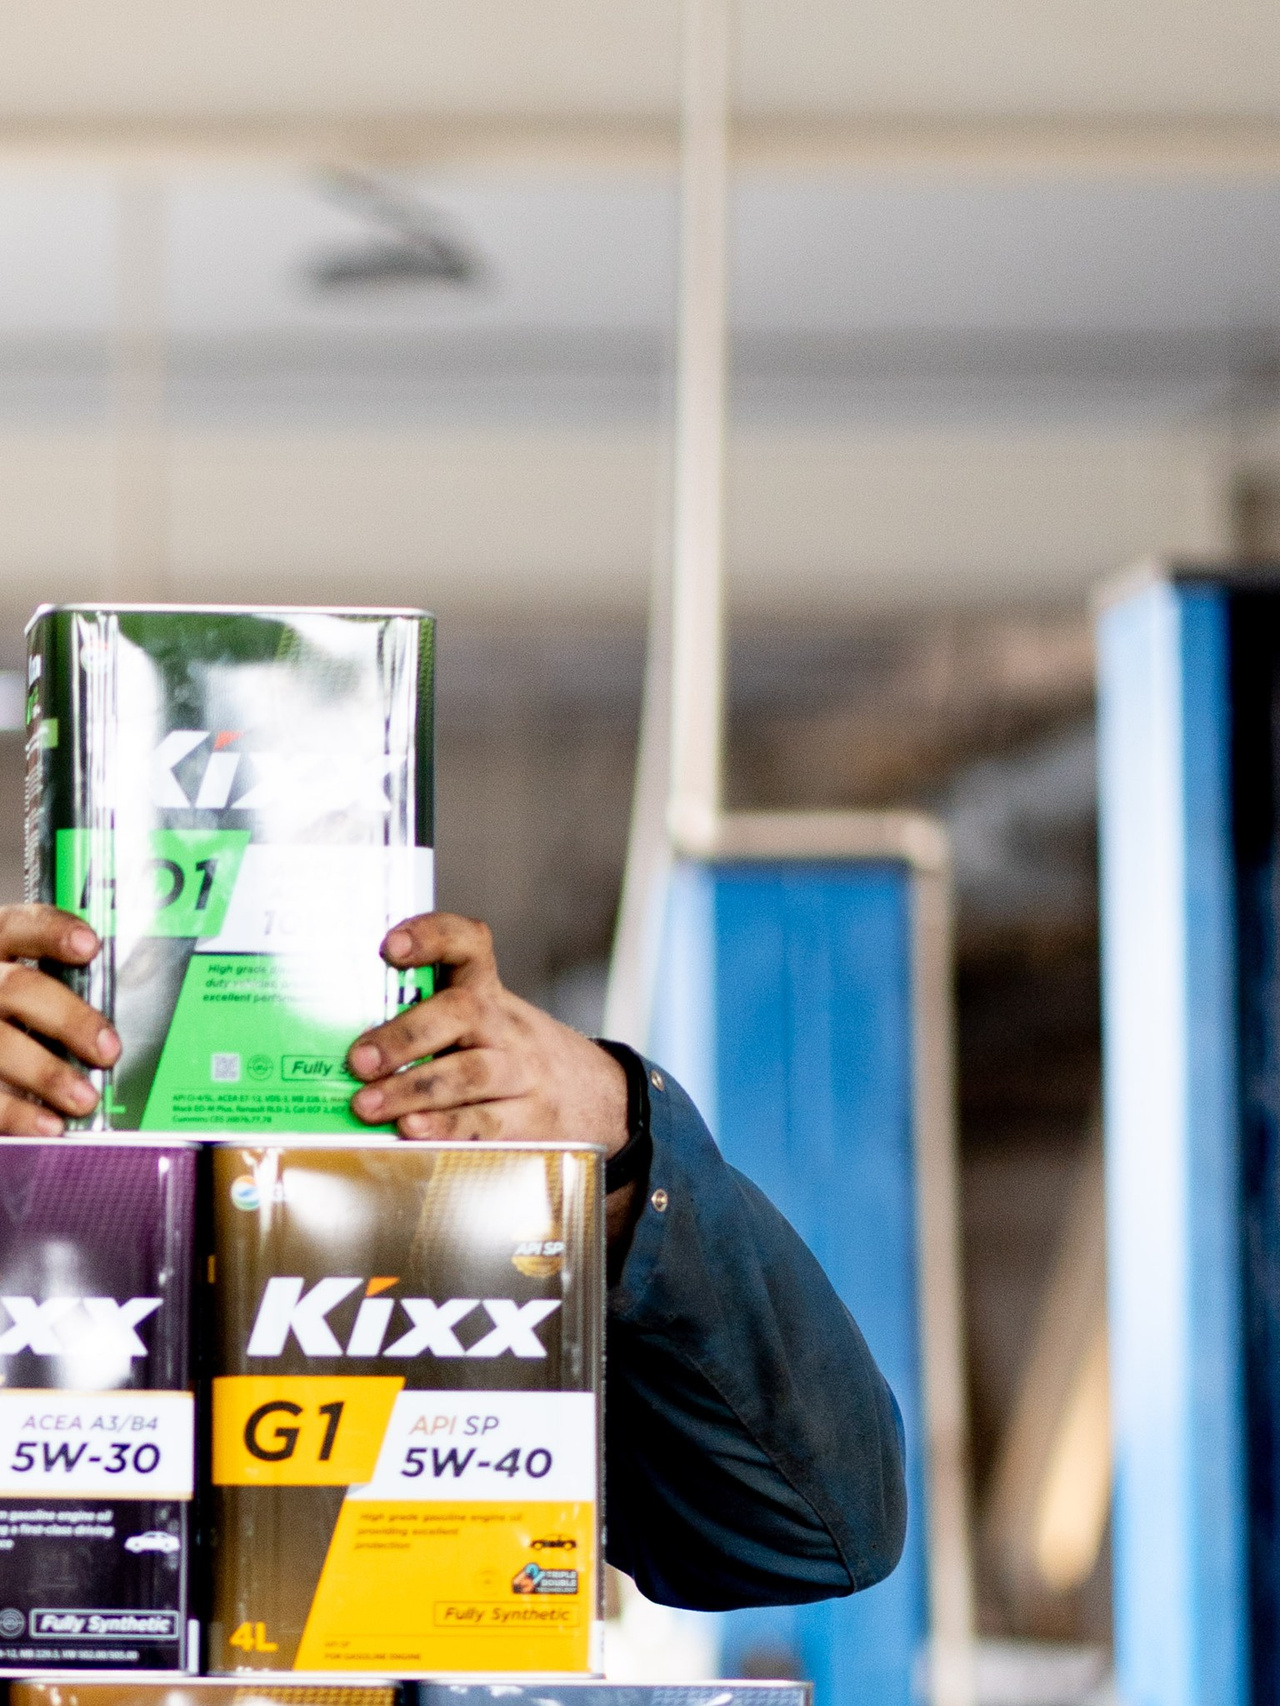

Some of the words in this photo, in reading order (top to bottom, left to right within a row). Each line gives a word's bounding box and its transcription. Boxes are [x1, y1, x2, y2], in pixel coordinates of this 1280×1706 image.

[292, 1060, 334, 1077] Fully
[247, 1277, 562, 1357] Kixx
[22, 1415, 82, 1431] ACEA
[91, 1416, 158, 1432] A3/B4
[243, 1400, 344, 1461] G1
[409, 1416, 455, 1435] API
[464, 1416, 499, 1435] SP
[11, 1442, 161, 1473] 5W-30
[401, 1447, 553, 1478] 5W-40
[41, 1615, 86, 1633] Fully
[88, 1615, 171, 1633] Synthetic
[445, 1607, 483, 1622] Fully
[492, 1607, 571, 1622] Synthetic
[230, 1622, 278, 1652] 4L
